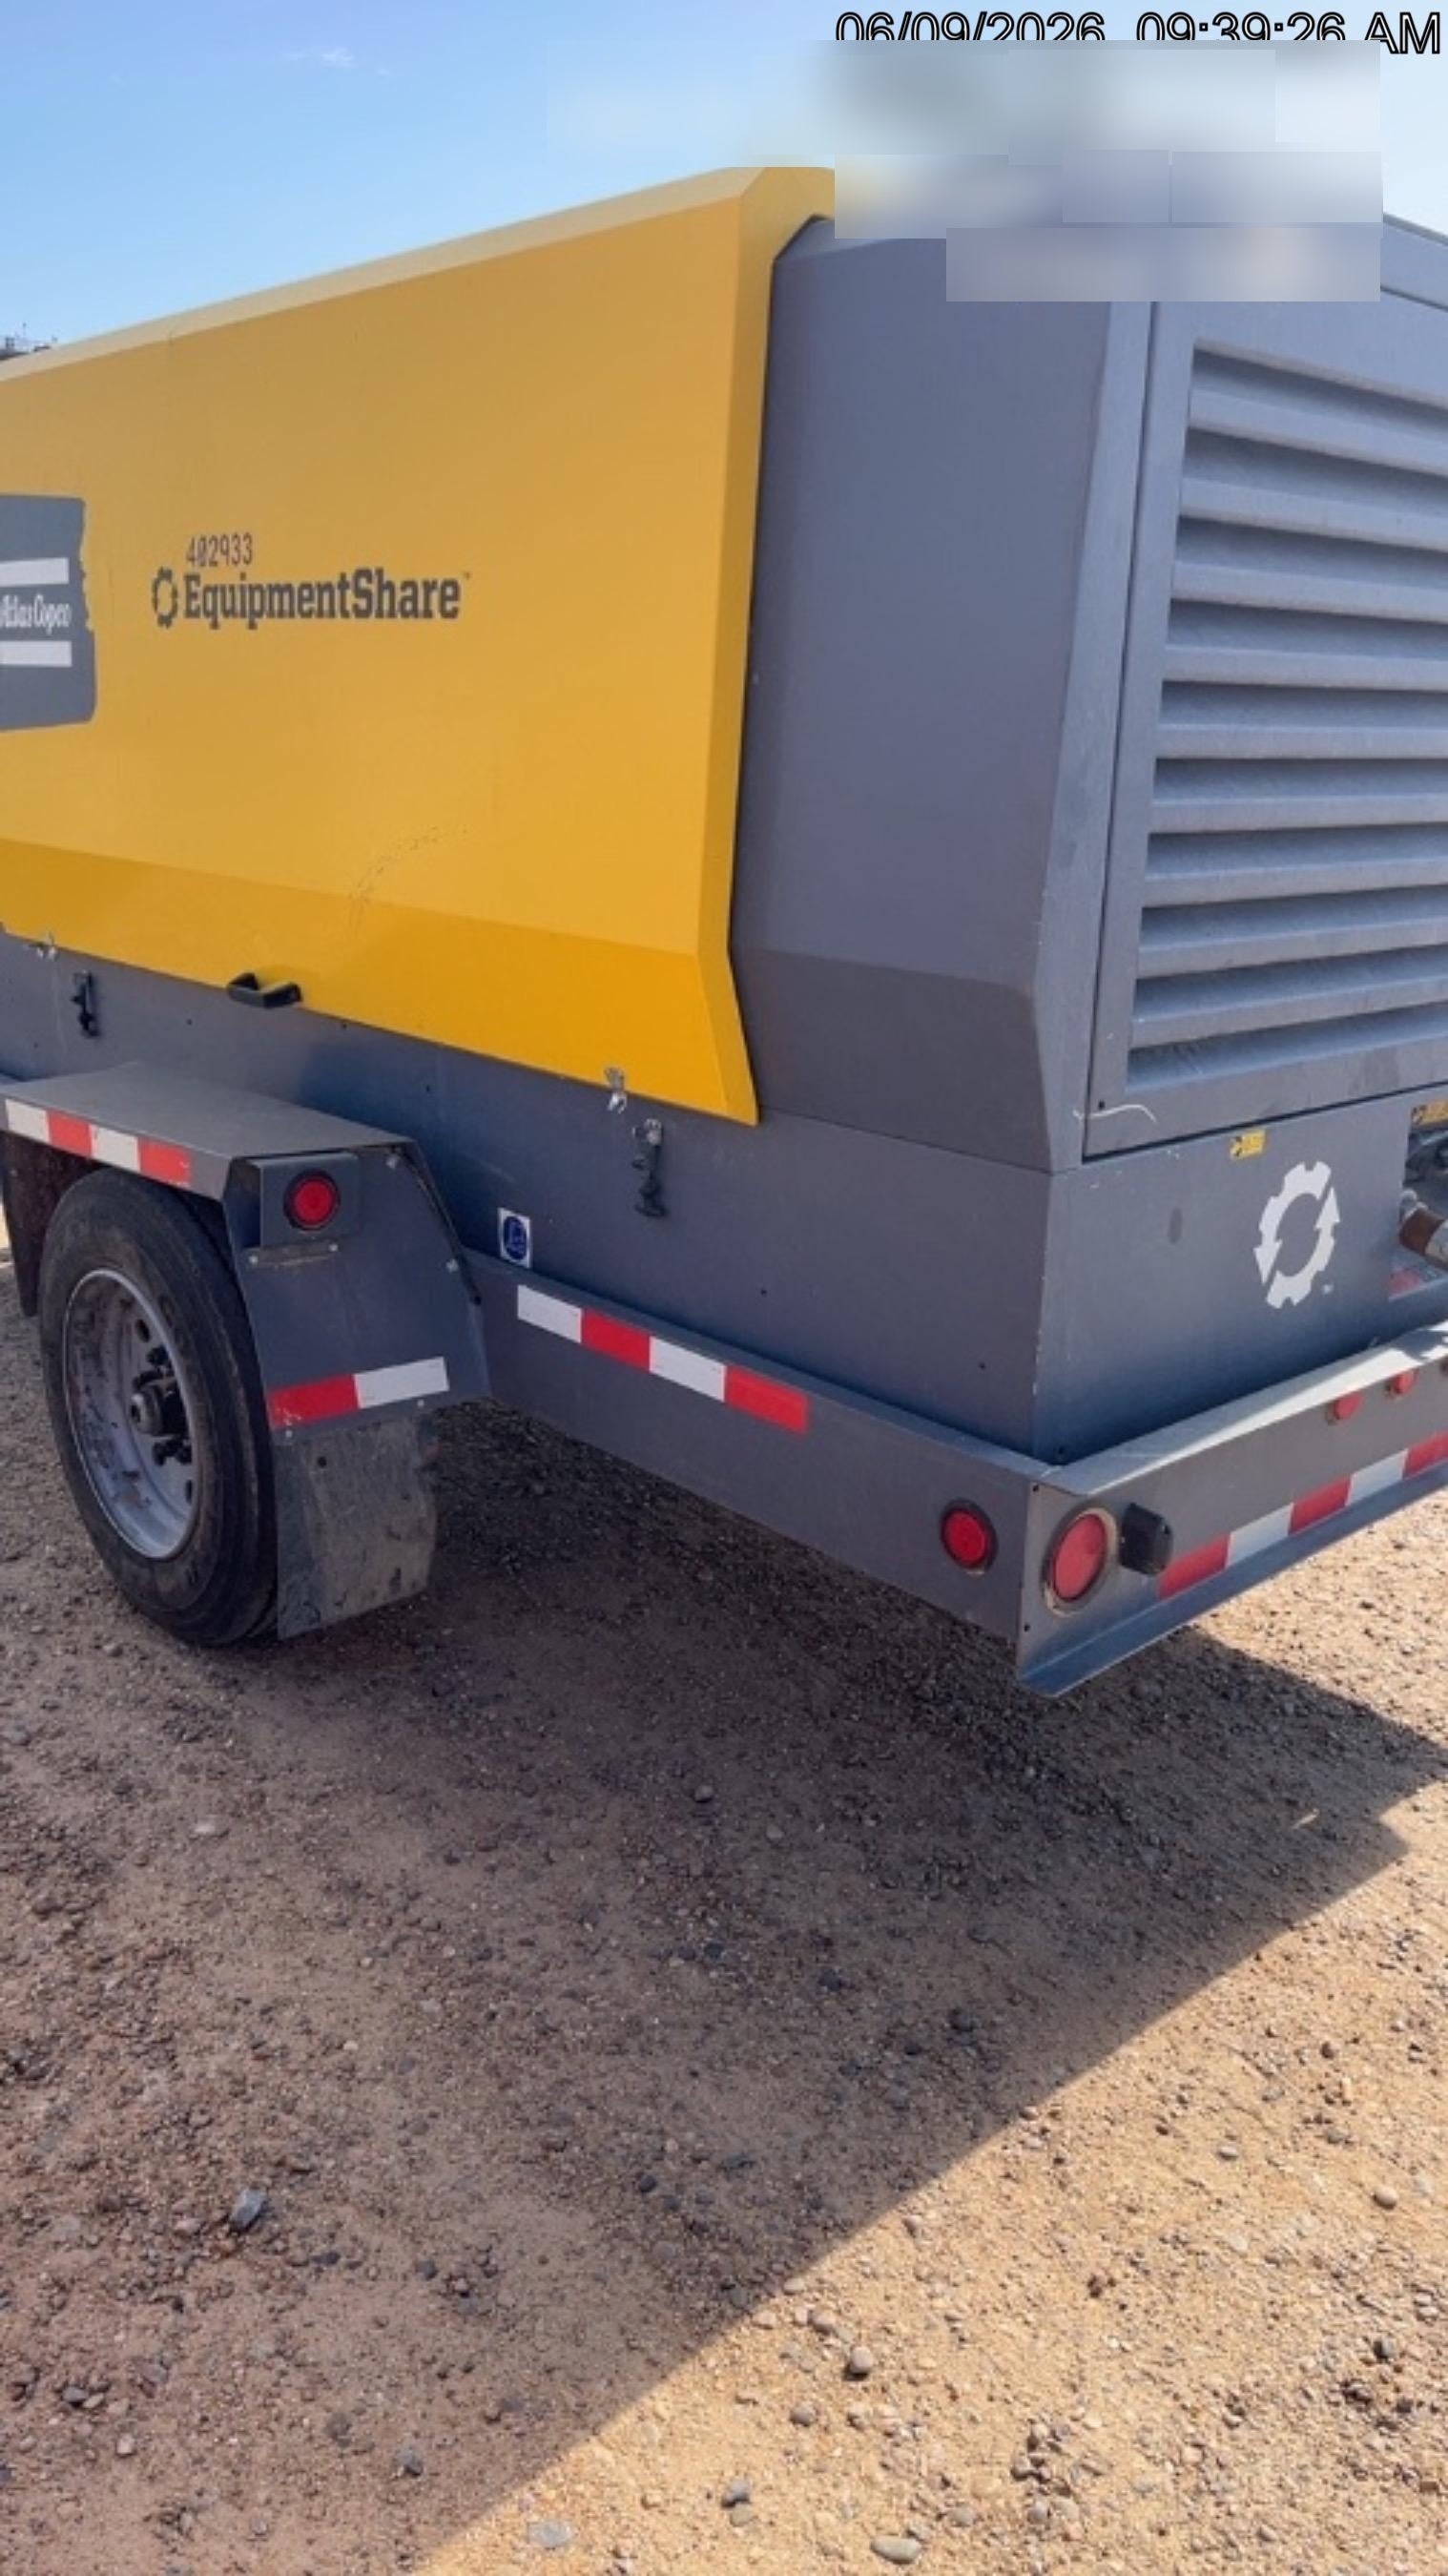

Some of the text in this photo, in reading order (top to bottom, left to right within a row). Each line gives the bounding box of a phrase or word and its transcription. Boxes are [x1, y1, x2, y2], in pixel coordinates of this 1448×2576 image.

[186, 532, 253, 567] 402933
[33, 594, 72, 636] Copco
[183, 568, 460, 630] EquipmentShare
